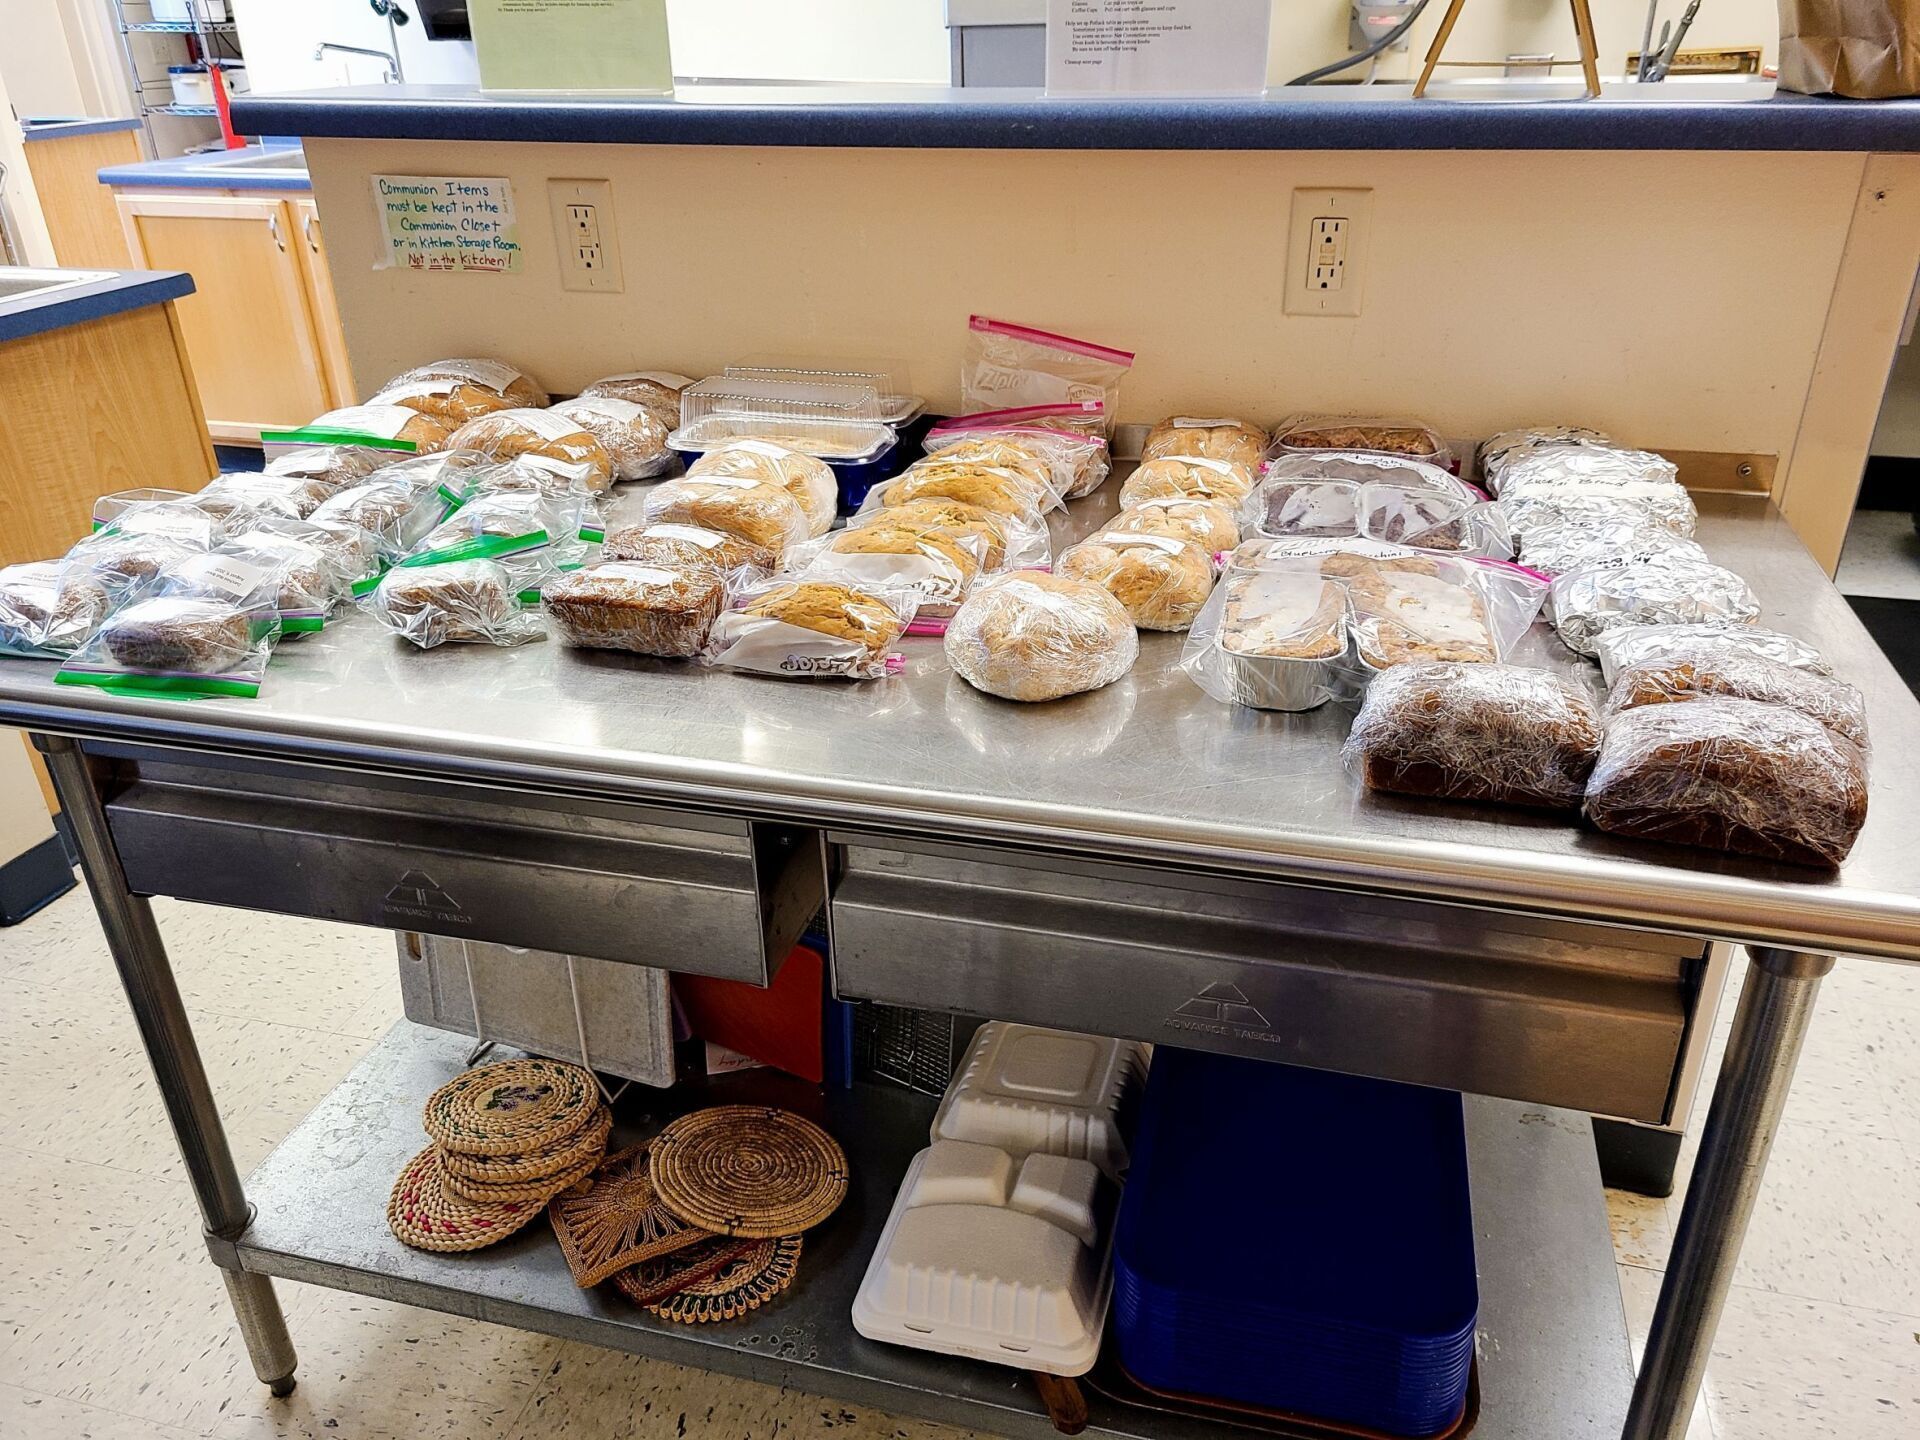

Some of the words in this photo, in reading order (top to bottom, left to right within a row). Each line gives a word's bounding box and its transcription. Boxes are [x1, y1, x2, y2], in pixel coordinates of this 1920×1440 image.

[379, 179, 438, 196] Communion
[445, 182, 489, 196] Items
[387, 200, 411, 212] must
[414, 200, 427, 212] be
[431, 201, 457, 215] kept
[462, 201, 474, 213] in
[476, 200, 499, 213] the
[400, 217, 457, 231] Communion
[461, 218, 501, 232] Closet
[393, 238, 405, 247] or
[408, 237, 417, 248] in
[456, 235, 491, 251] Storage
[408, 252, 425, 264] Not
[430, 253, 440, 264] in
[441, 252, 456, 264] the
[1163, 1017, 1229, 1035] ADVANCE
[1234, 1028, 1281, 1043] TABCO
